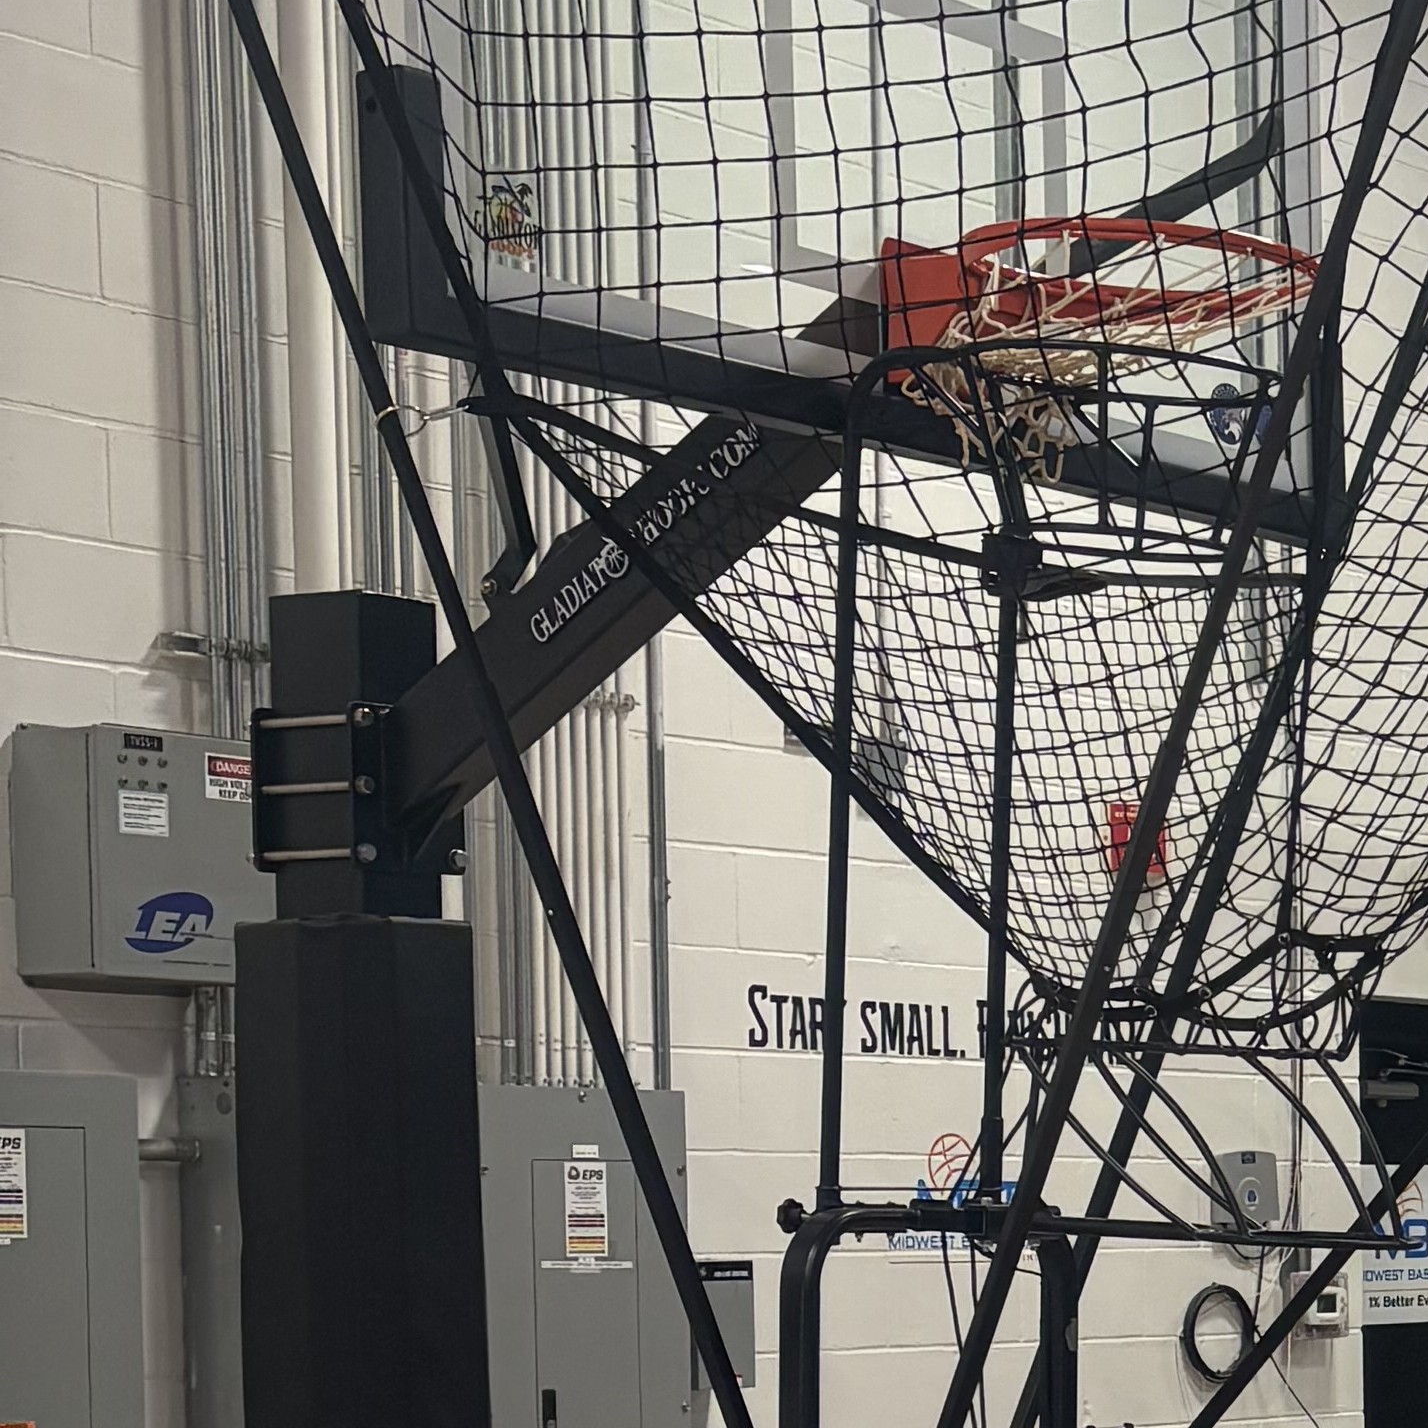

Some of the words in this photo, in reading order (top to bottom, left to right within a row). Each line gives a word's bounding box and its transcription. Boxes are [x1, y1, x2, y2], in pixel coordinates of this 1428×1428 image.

[215, 760, 251, 775] DANGE
[125, 909, 207, 942] LEA
[748, 984, 847, 1050] STAR
[860, 999, 966, 1058] SMALL.
[582, 1169, 604, 1181] EPS
[1369, 1296, 1380, 1308] 1%
[1383, 1295, 1415, 1308] Better
